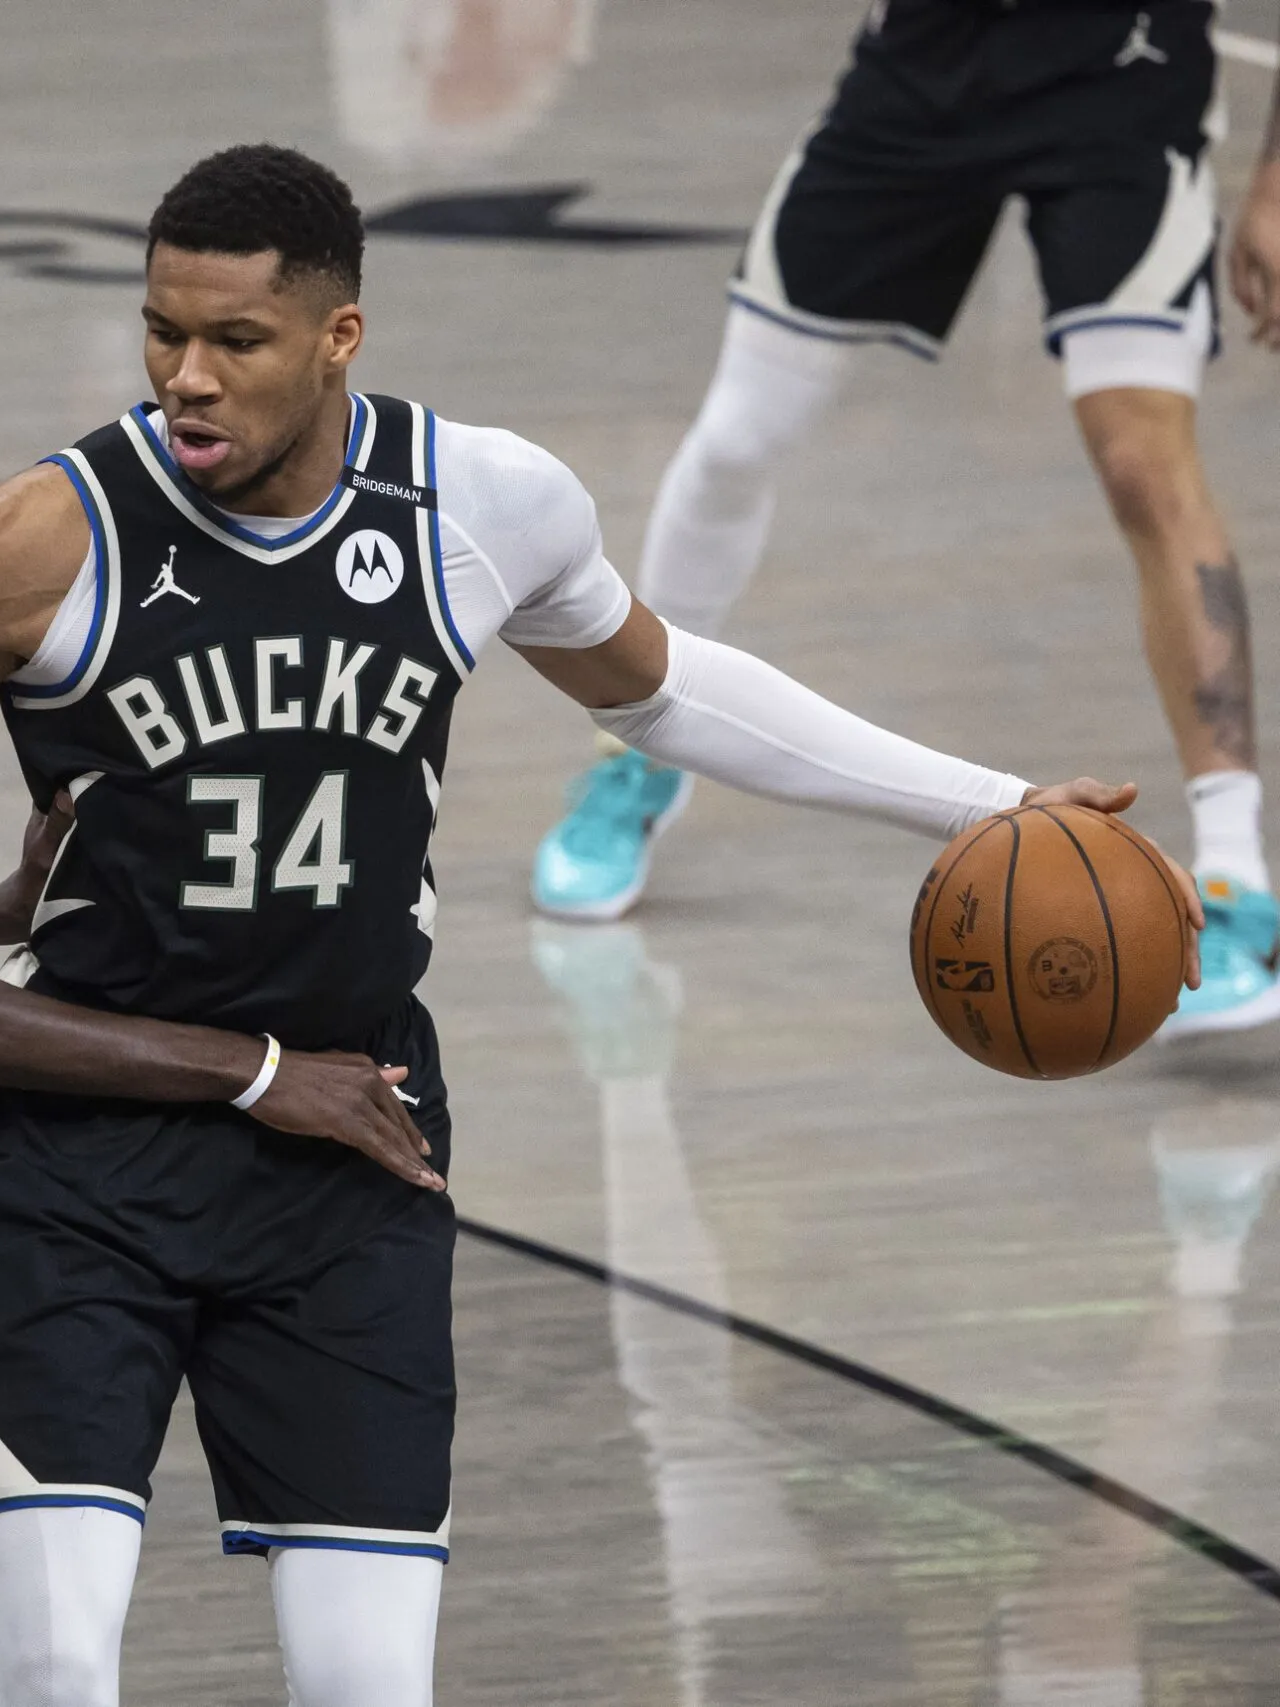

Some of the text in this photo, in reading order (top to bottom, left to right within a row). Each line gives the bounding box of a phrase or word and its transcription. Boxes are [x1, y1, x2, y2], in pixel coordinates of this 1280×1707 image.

[352, 474, 422, 503] BRIDGEMAN
[104, 635, 441, 772] BUCKS
[179, 770, 356, 912] 34
